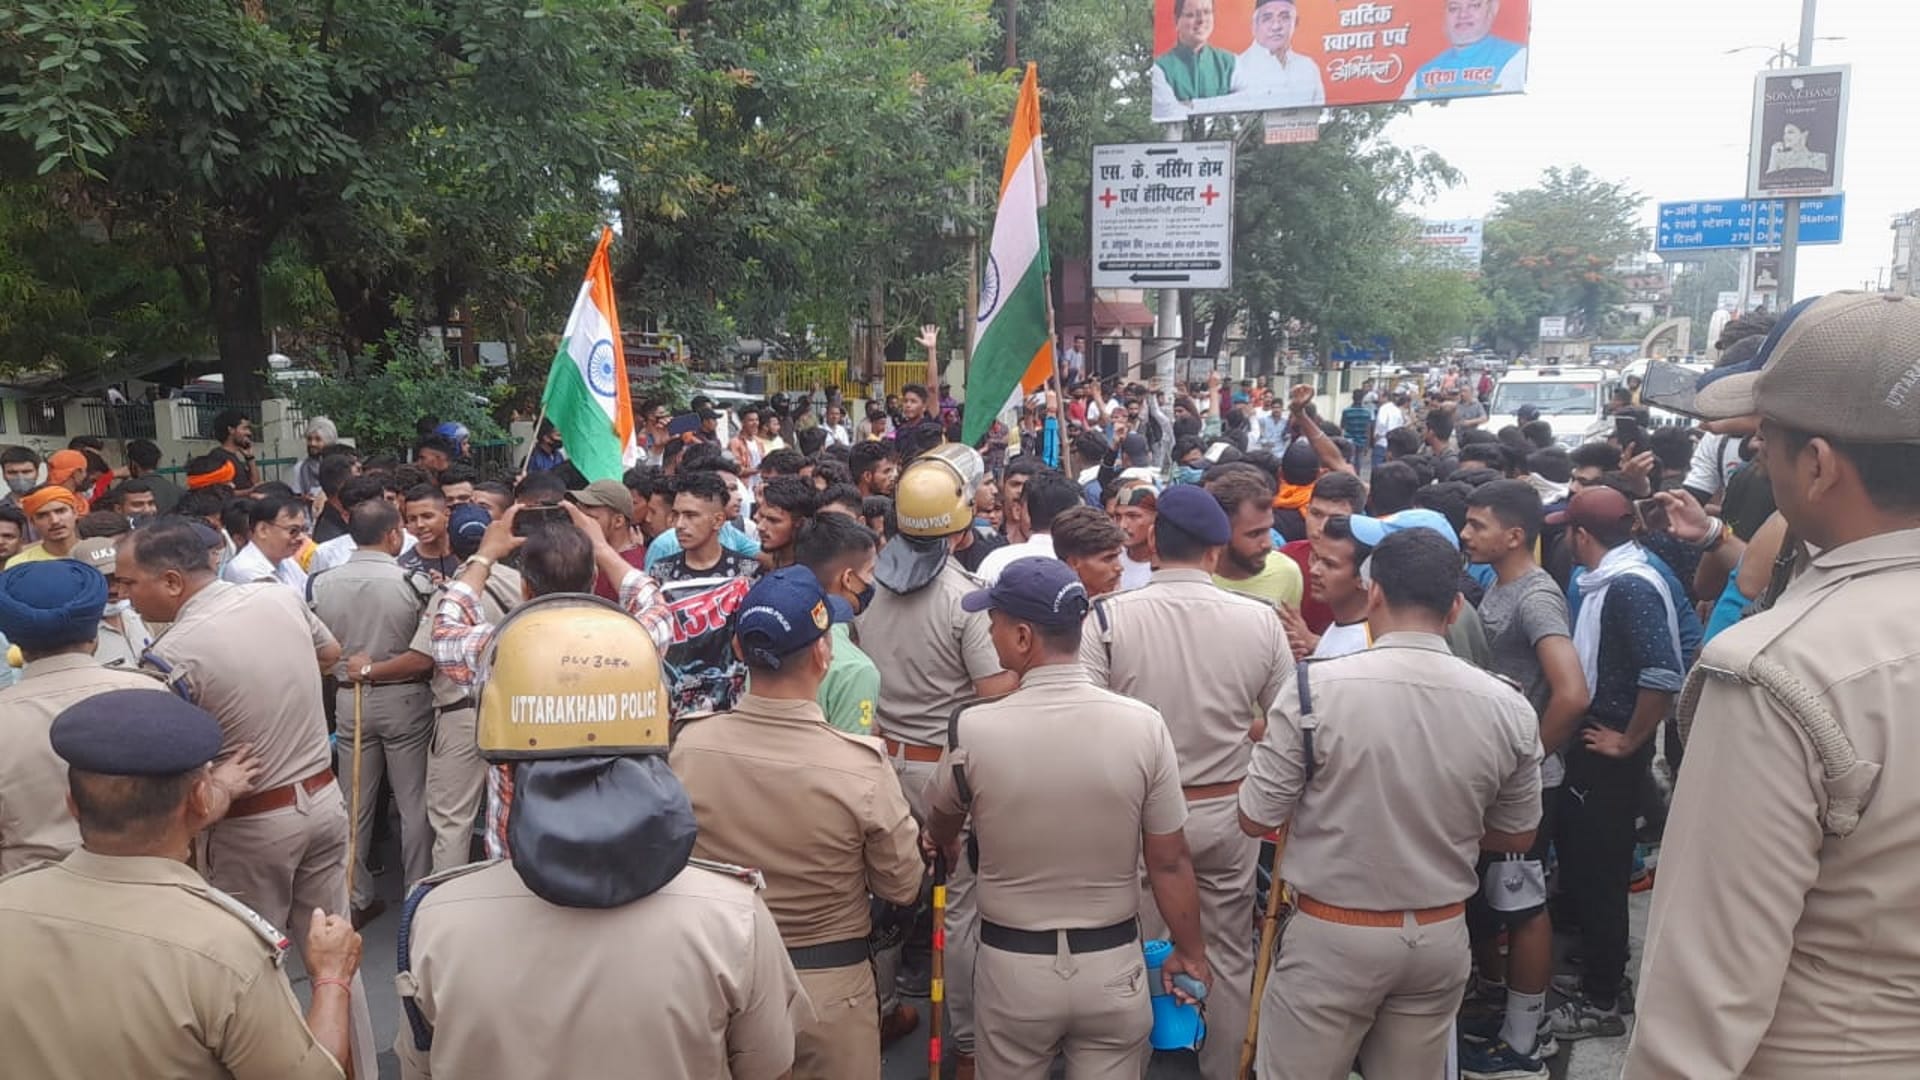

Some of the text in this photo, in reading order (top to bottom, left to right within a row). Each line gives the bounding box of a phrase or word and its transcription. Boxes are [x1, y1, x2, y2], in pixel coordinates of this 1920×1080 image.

[1340, 4, 1393, 26] हार्दिक
[1323, 23, 1411, 52] स्वागत एवं
[1100, 157, 1224, 180] एस. के. नर्सिंग होम
[1120, 183, 1196, 203] एवं हॉस्पिटल
[1799, 214, 1838, 223] Station
[511, 689, 657, 724] UTTARAKHAND POLICE
